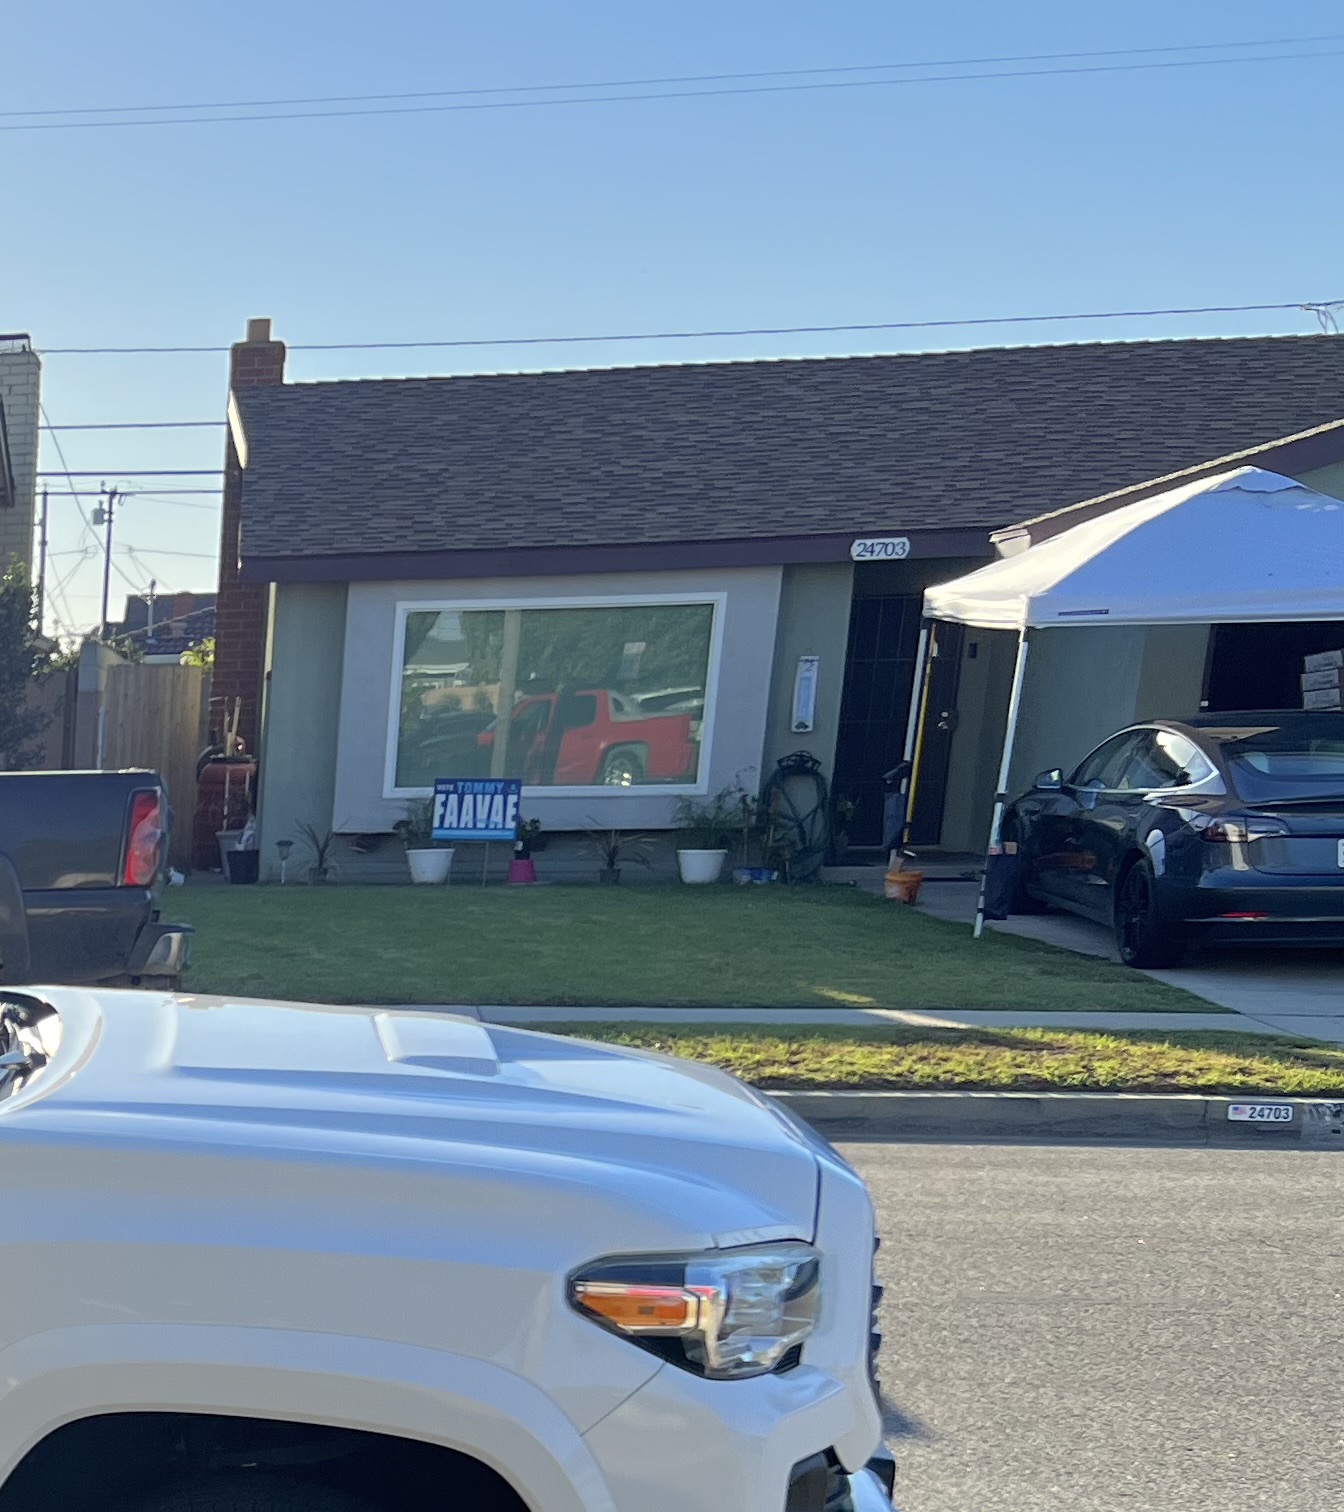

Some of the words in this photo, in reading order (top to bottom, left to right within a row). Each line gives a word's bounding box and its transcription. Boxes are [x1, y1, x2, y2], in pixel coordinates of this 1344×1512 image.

[855, 541, 907, 558] 24703
[457, 781, 505, 794] TOMMY
[432, 793, 519, 829] FAAVAE
[1248, 1106, 1291, 1120] 24703
